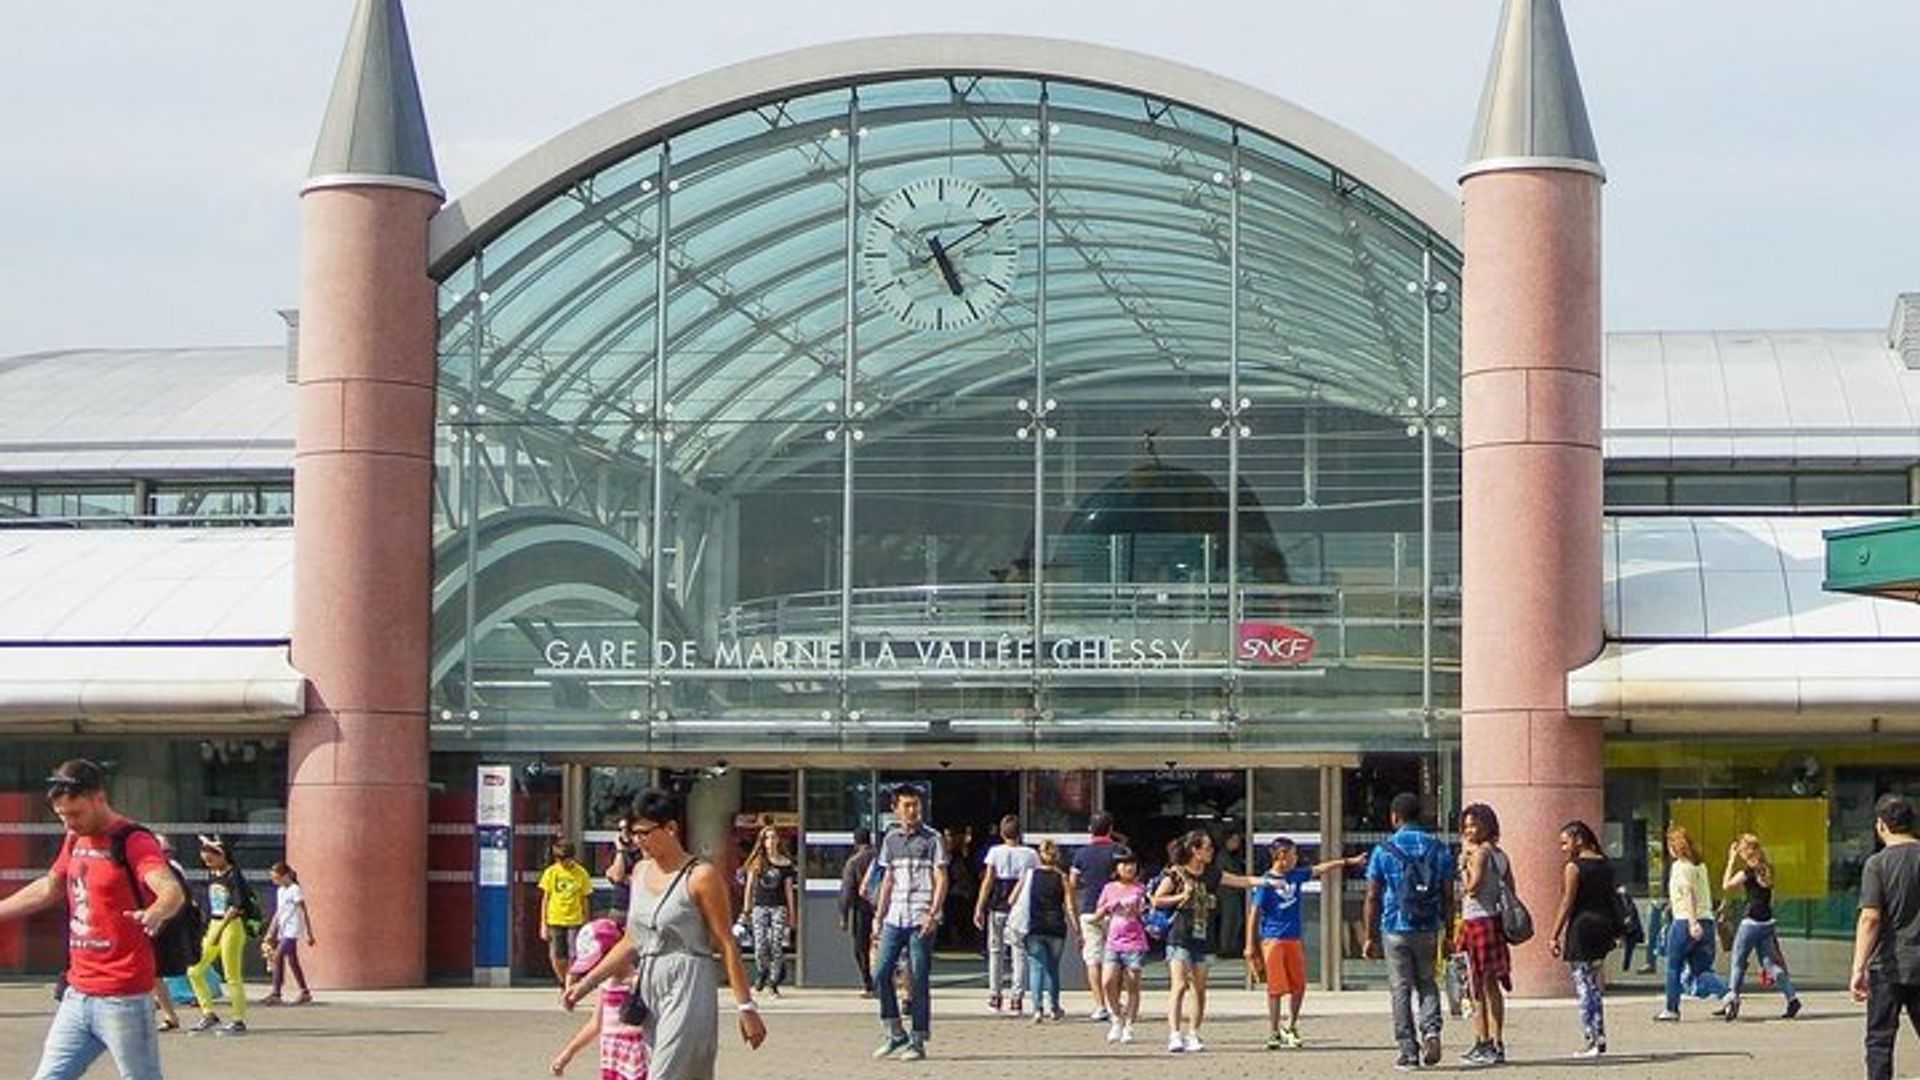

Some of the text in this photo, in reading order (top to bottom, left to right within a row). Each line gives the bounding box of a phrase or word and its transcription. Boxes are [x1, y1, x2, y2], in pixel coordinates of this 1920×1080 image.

[544, 632, 1191, 668] GARE DE MARNE LA VALLÉE CHESSY
[1240, 637, 1309, 659] SNCF
